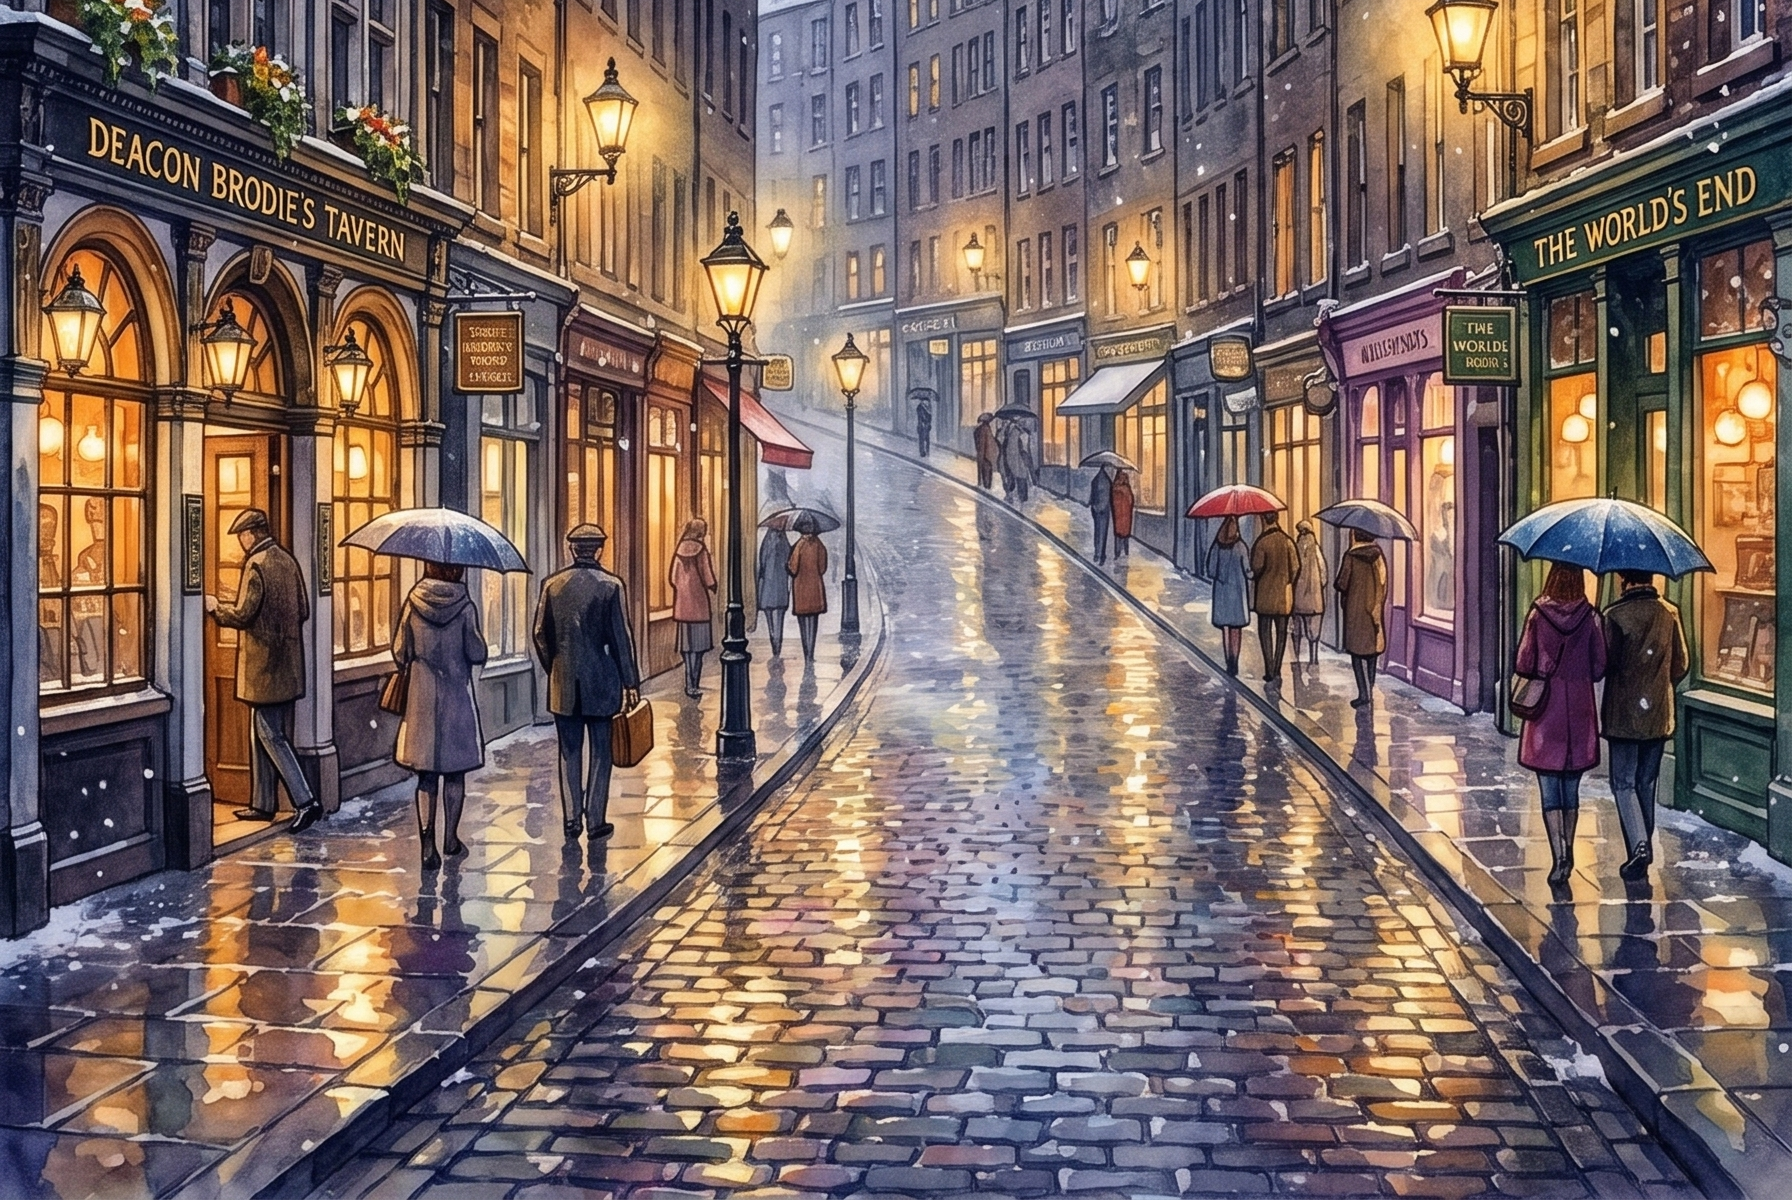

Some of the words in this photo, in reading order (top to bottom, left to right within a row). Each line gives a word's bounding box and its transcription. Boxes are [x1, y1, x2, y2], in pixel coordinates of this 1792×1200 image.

[87, 116, 200, 193] DEACON
[211, 162, 316, 230] BRODIE'S
[324, 200, 406, 263] TAVERN
[1534, 227, 1578, 269] THE
[1584, 186, 1688, 252] WORLD'S
[1696, 166, 1757, 218] END
